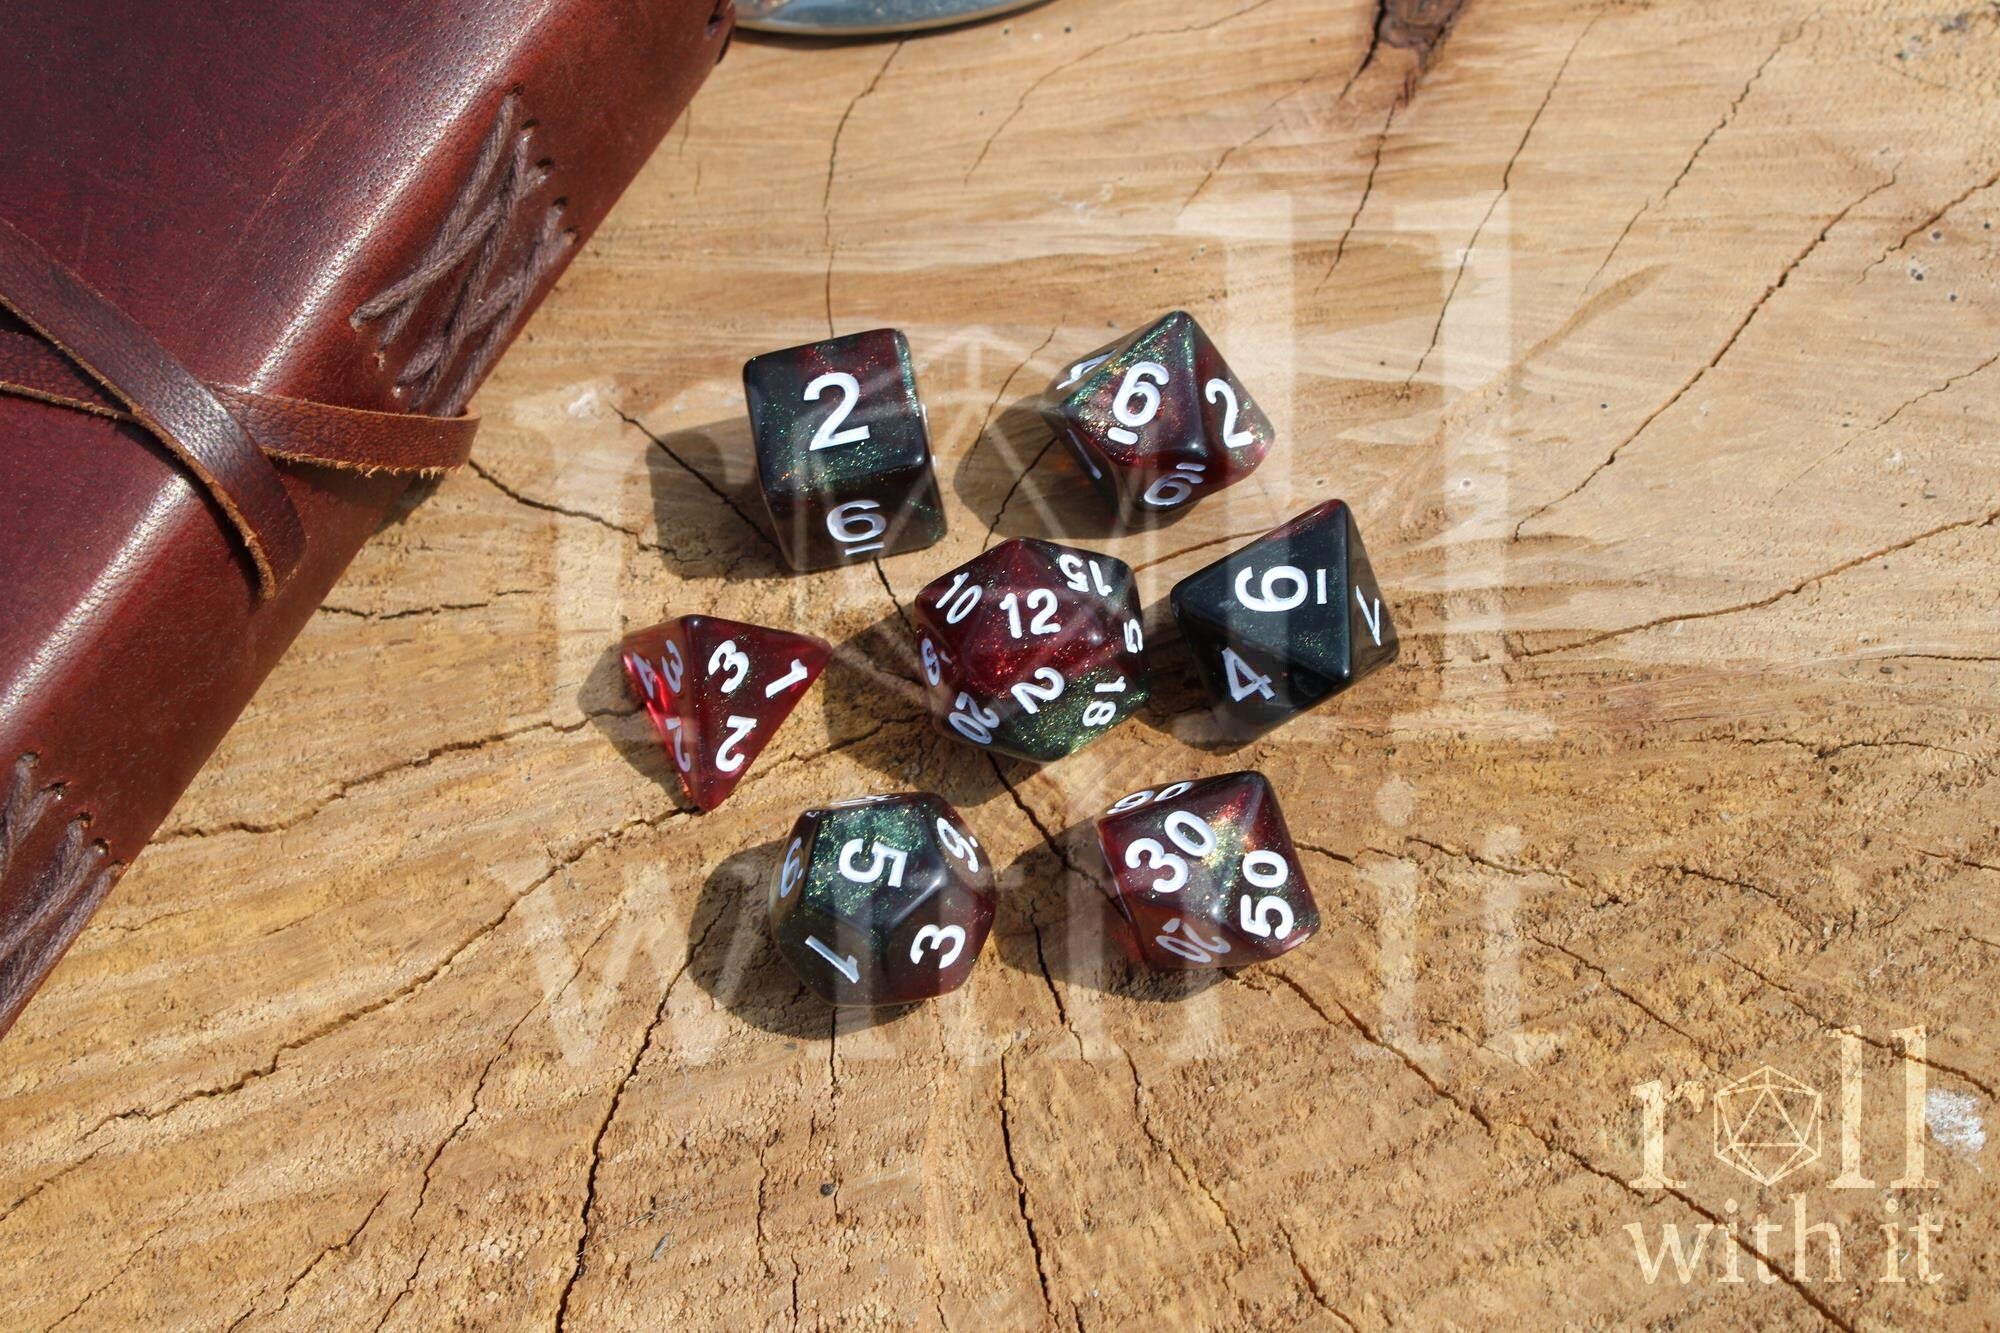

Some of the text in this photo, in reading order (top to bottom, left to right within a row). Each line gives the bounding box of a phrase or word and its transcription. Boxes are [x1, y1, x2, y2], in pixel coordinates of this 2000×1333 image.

[803, 372, 870, 451] 2
[1107, 361, 1170, 445] 6
[1205, 378, 1254, 448] 2
[826, 500, 887, 555] 6
[935, 572, 983, 624] 10
[1059, 554, 1113, 596] 15
[1234, 565, 1328, 612] 6
[999, 588, 1061, 639] 12
[708, 640, 749, 693] 3
[765, 658, 808, 698] 1
[1010, 667, 1065, 714] 2
[1221, 647, 1276, 702] 4
[949, 692, 999, 744] 20
[1082, 676, 1127, 727] 18
[715, 715, 757, 772] 2
[838, 838, 908, 888] 5
[1125, 810, 1217, 893] 30
[1240, 850, 1294, 940] 50
[804, 935, 860, 984] 1
[909, 924, 966, 969] 3
